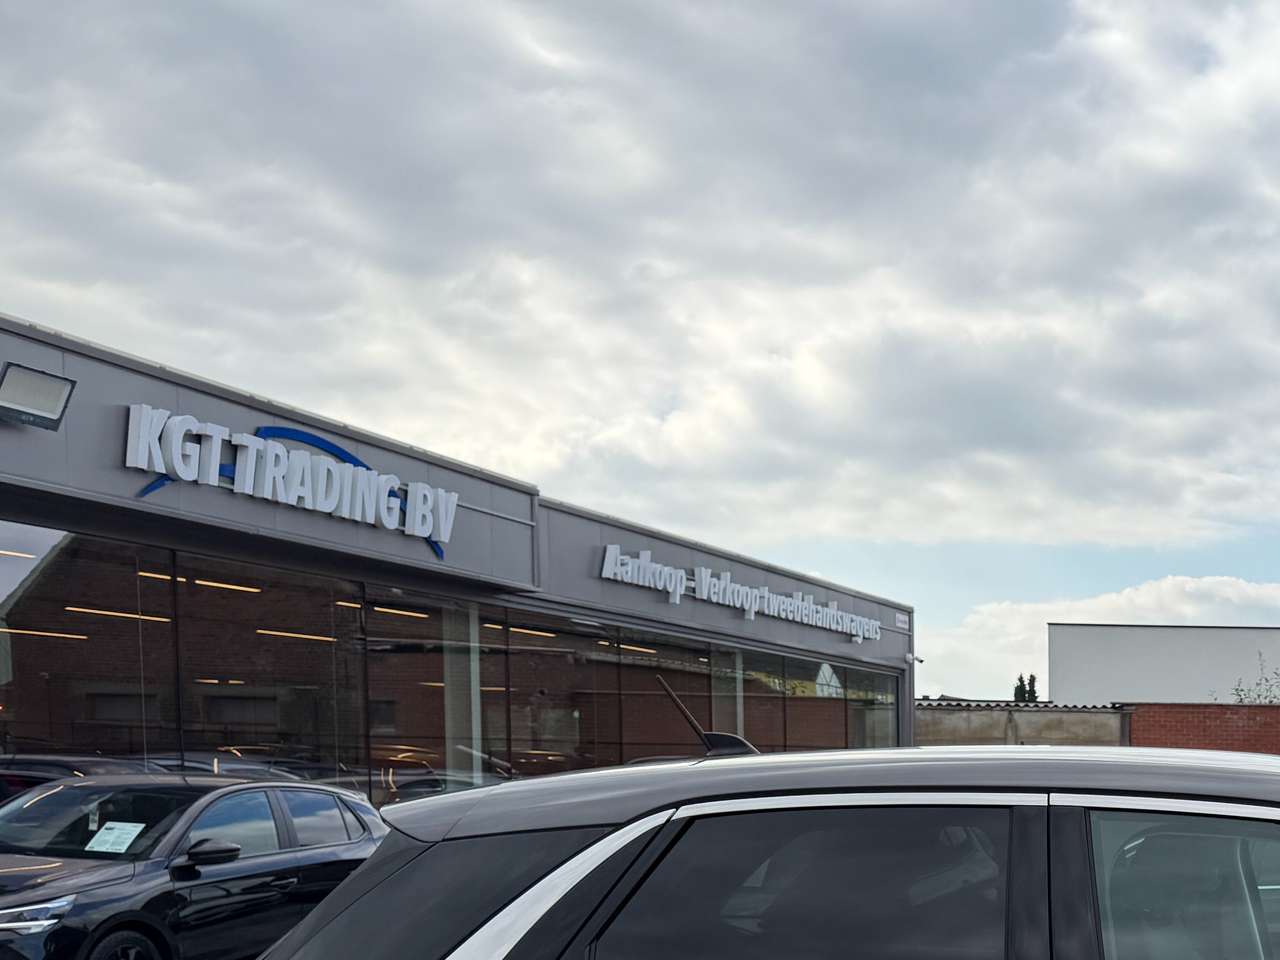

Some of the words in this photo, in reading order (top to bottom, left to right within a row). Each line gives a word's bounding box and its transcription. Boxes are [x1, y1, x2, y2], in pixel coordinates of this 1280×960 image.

[125, 403, 229, 487] KGT
[231, 432, 401, 531] TRADING
[404, 482, 458, 543] BV
[602, 544, 687, 604] Aankoop
[695, 566, 760, 620] Verkoop
[761, 586, 881, 644] tweedehandswagens
